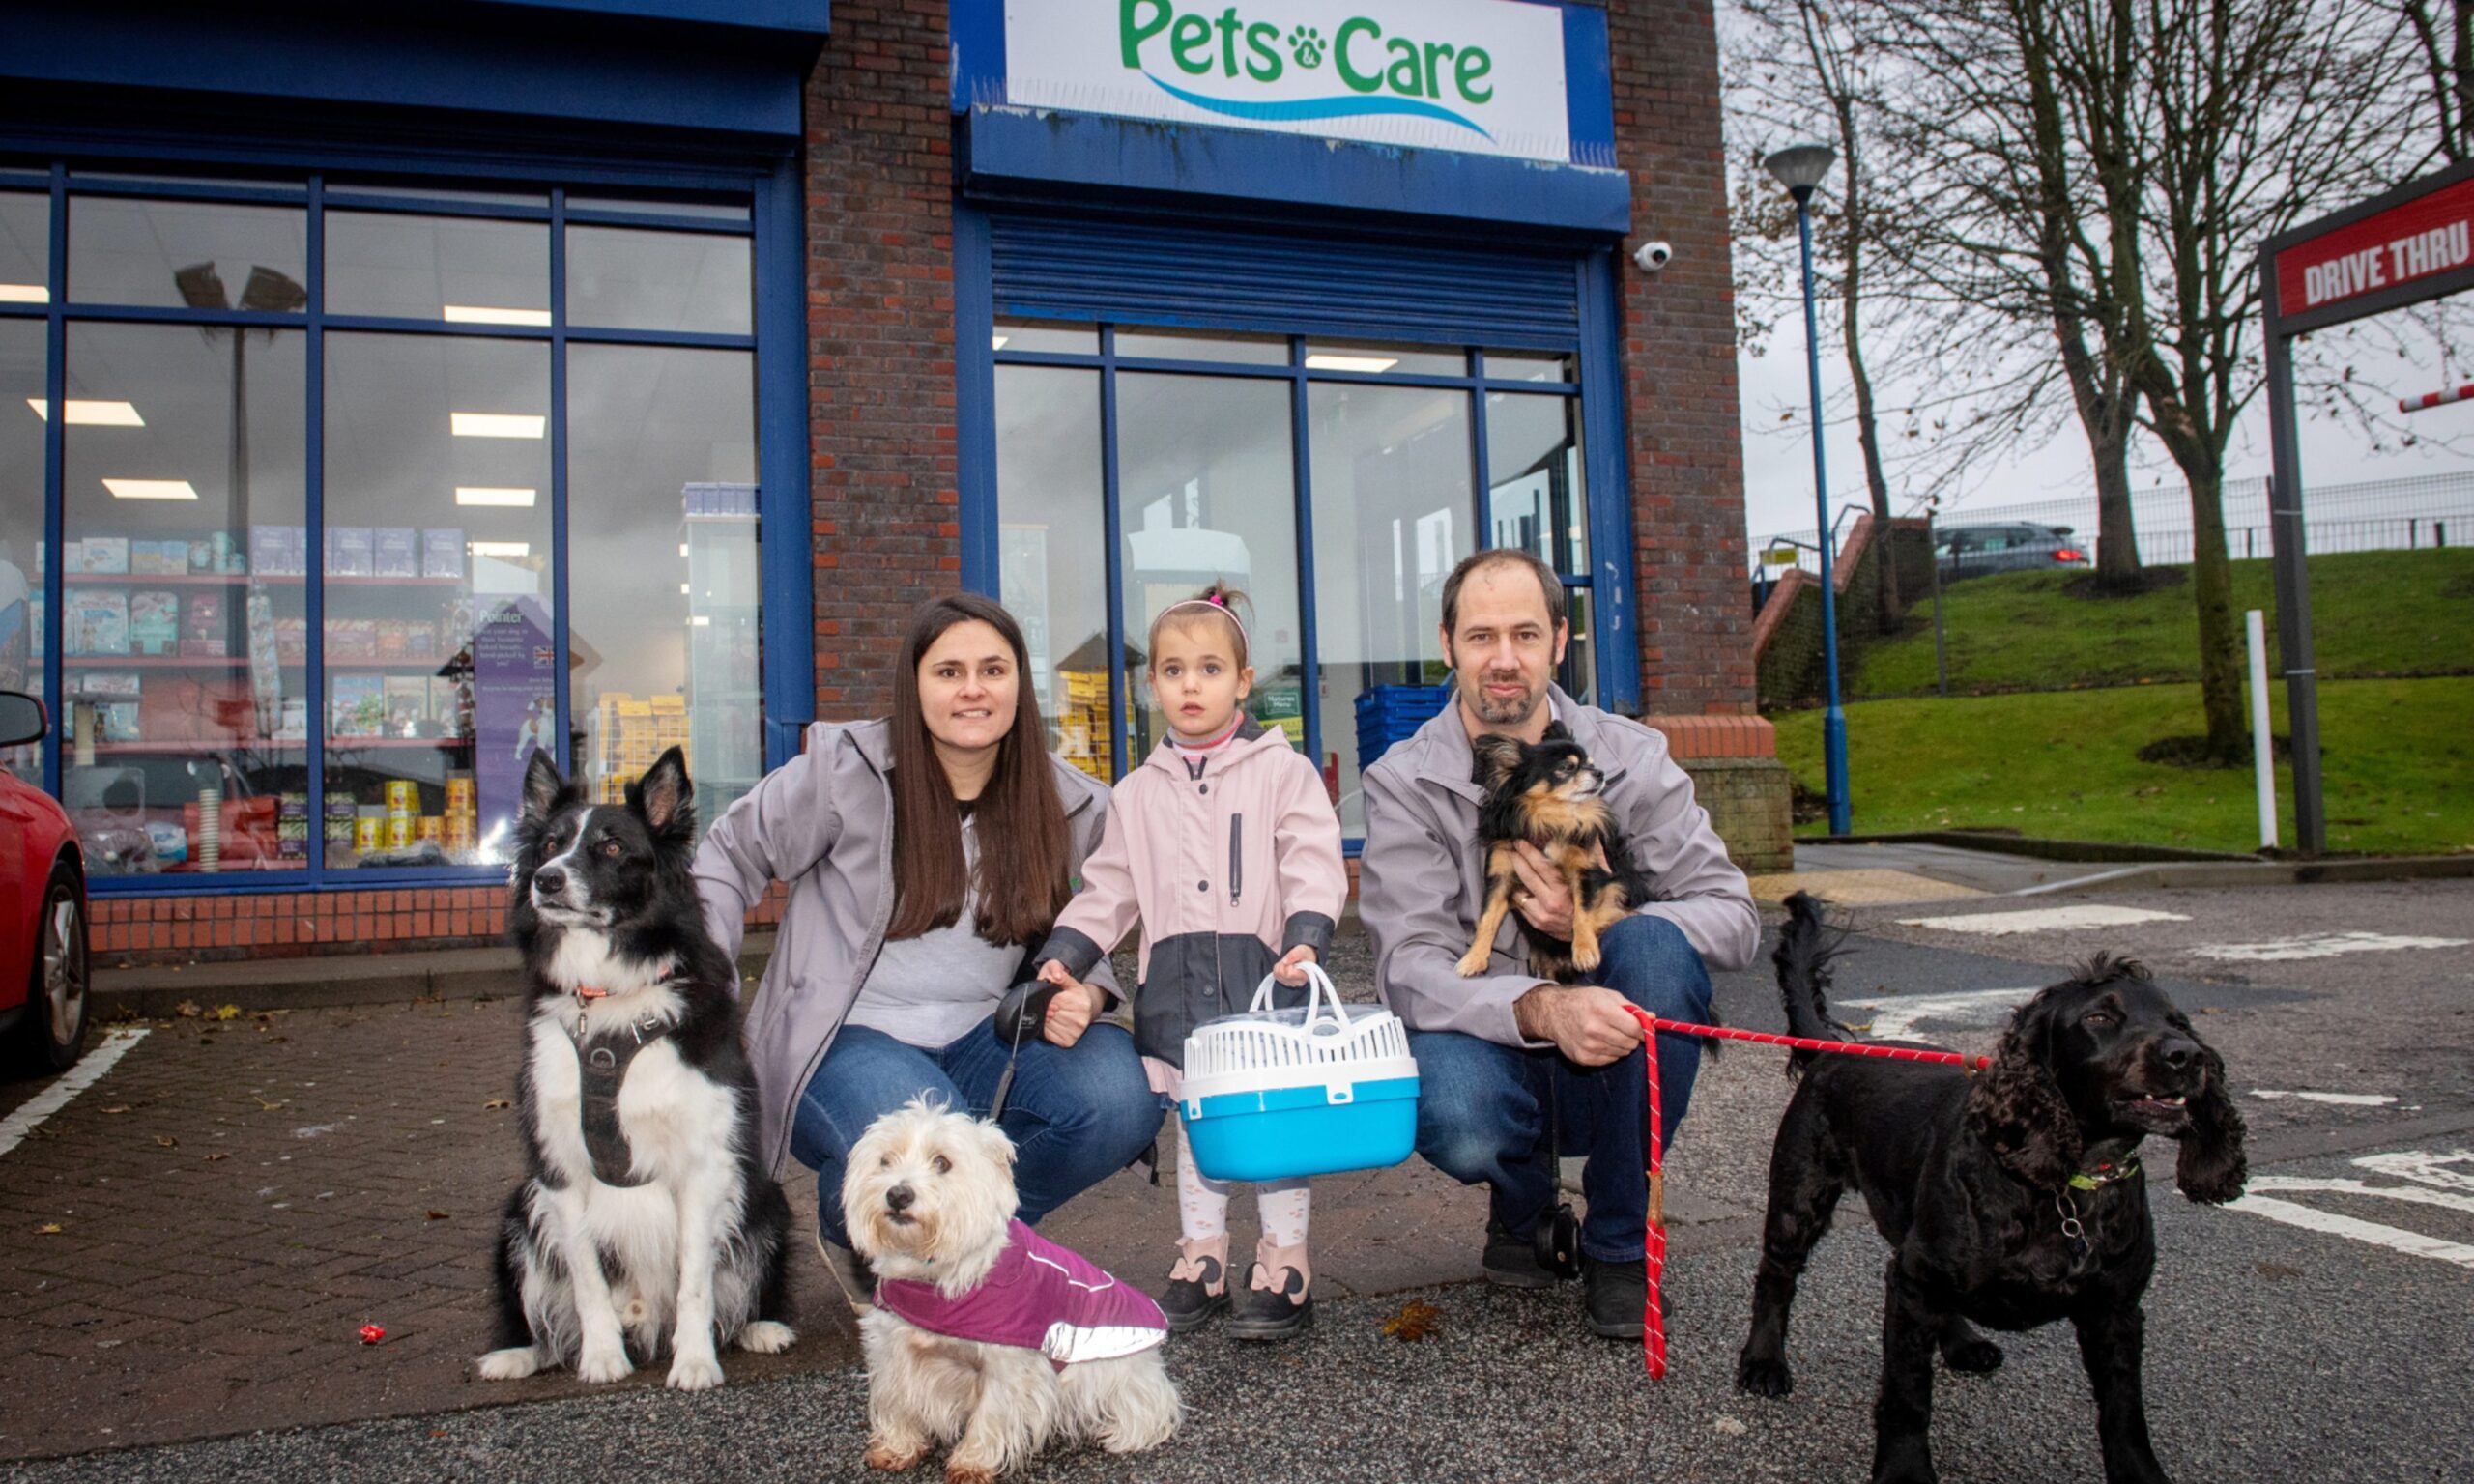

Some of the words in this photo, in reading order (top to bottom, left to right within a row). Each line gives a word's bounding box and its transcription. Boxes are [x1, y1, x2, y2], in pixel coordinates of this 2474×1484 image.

[1119, 0, 1283, 82] Pets
[1301, 46, 1318, 67] &
[1334, 16, 1494, 104] Care
[2304, 245, 2386, 306] DRIVE
[2388, 220, 2470, 281] THRU
[478, 610, 523, 624] Pointer
